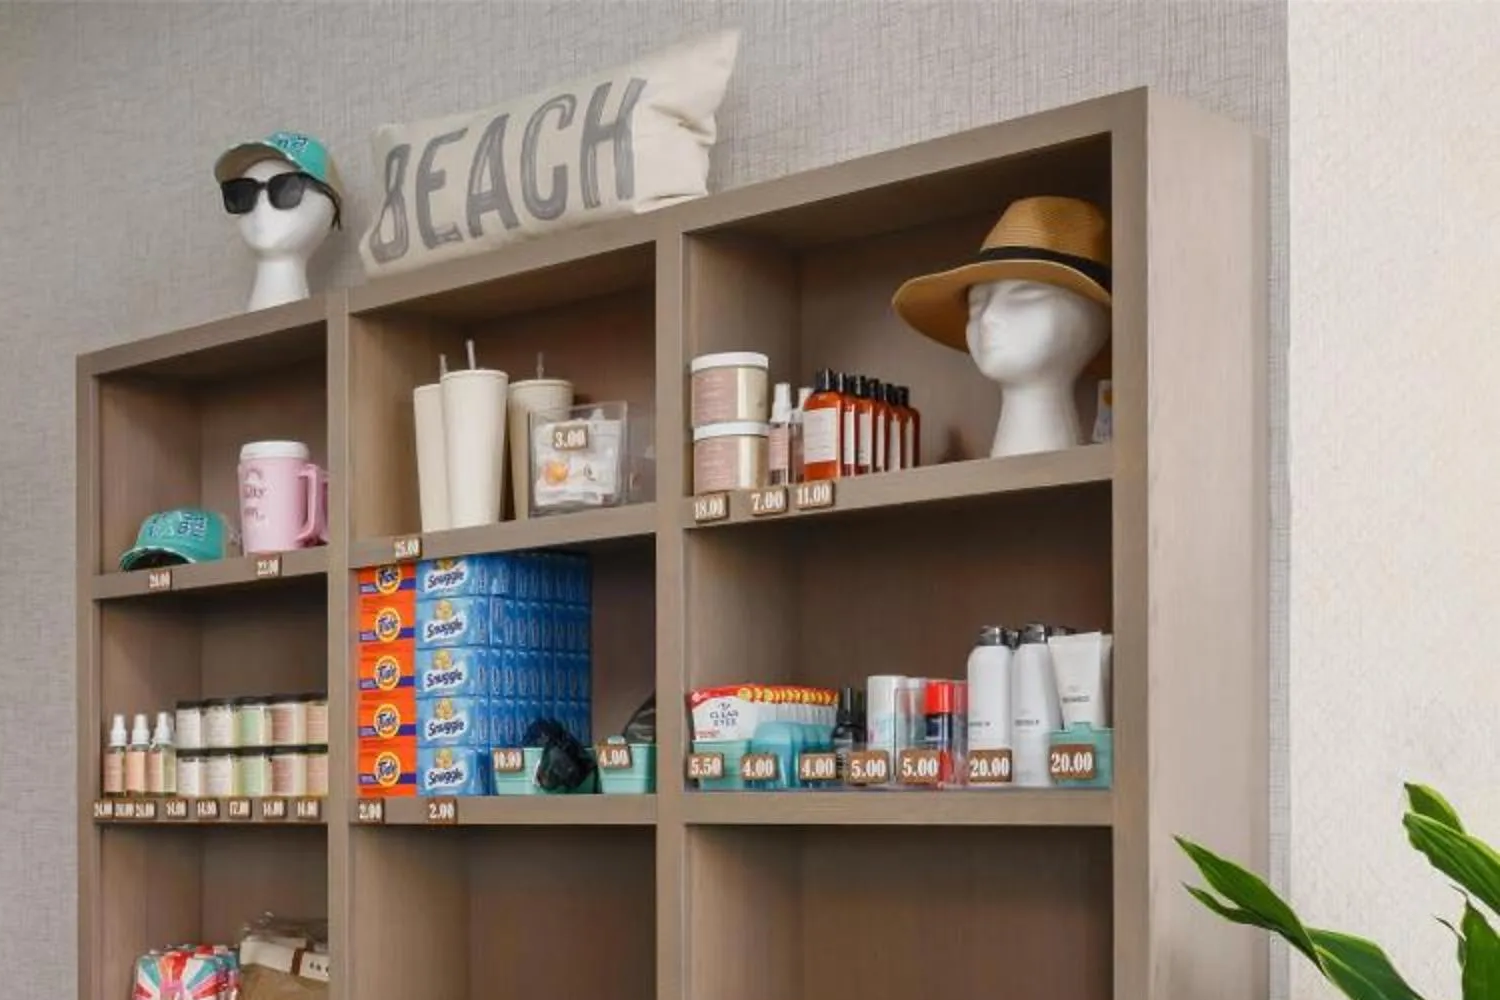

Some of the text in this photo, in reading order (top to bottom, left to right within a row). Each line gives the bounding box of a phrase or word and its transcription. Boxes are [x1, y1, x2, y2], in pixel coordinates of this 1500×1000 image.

[368, 77, 648, 264] BEACH
[743, 762, 773, 777] 4.00
[801, 761, 833, 776] 4.00
[851, 761, 886, 778] 5.00
[902, 758, 939, 777] 5.00
[970, 759, 1010, 777] 20.00
[1051, 752, 1093, 773] 20.00
